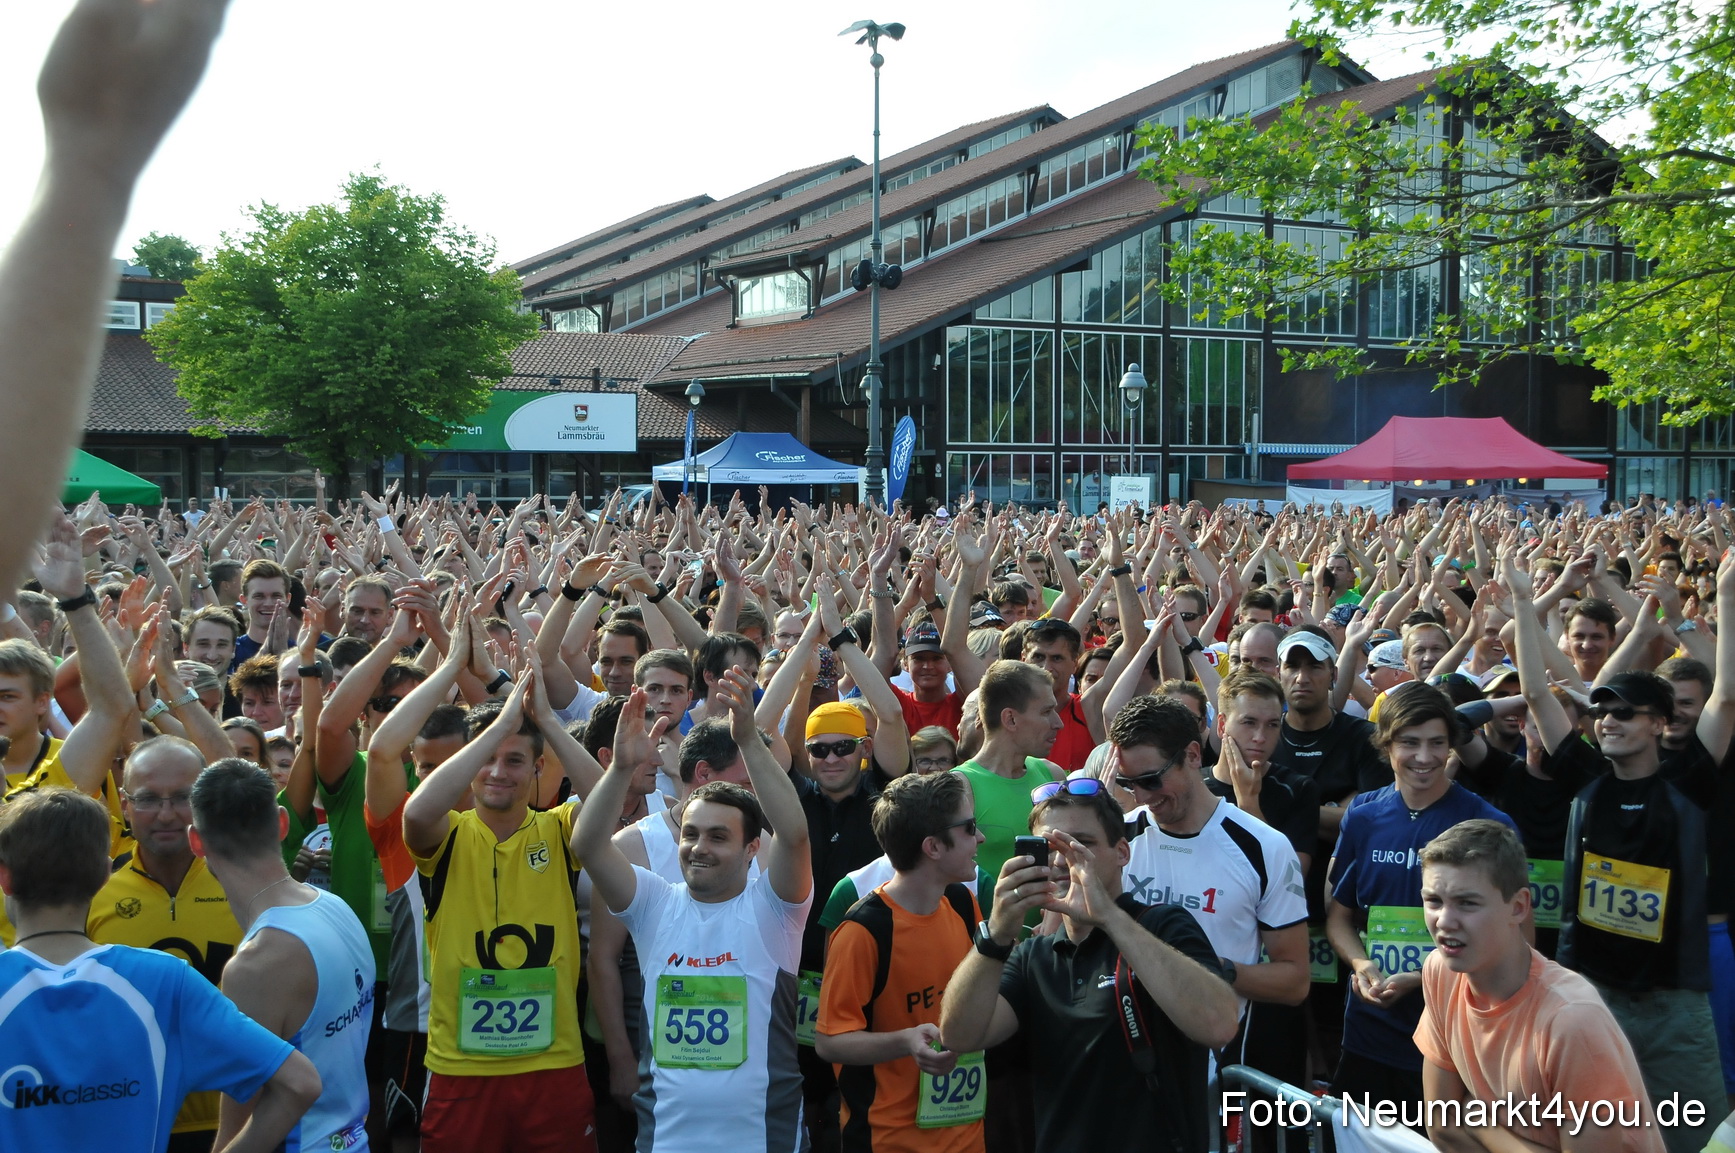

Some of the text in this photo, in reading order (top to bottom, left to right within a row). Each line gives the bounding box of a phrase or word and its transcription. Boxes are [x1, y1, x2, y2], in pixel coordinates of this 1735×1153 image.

[442, 425, 482, 435] men
[557, 431, 605, 440] Lammsbräu
[757, 451, 806, 461] Fischer
[729, 471, 751, 480] Fischer
[834, 472, 856, 480] Fischer
[1130, 499, 1144, 507] Srt
[530, 849, 548, 866] FC
[1372, 850, 1405, 864] EURO
[1584, 880, 1659, 922] 1133
[686, 952, 738, 968] KLEBL
[471, 999, 540, 1034] 232
[1122, 995, 1140, 1038] Canon
[665, 1008, 729, 1045] 558
[62, 1078, 141, 1105] classic
[931, 1066, 982, 1104] 929
